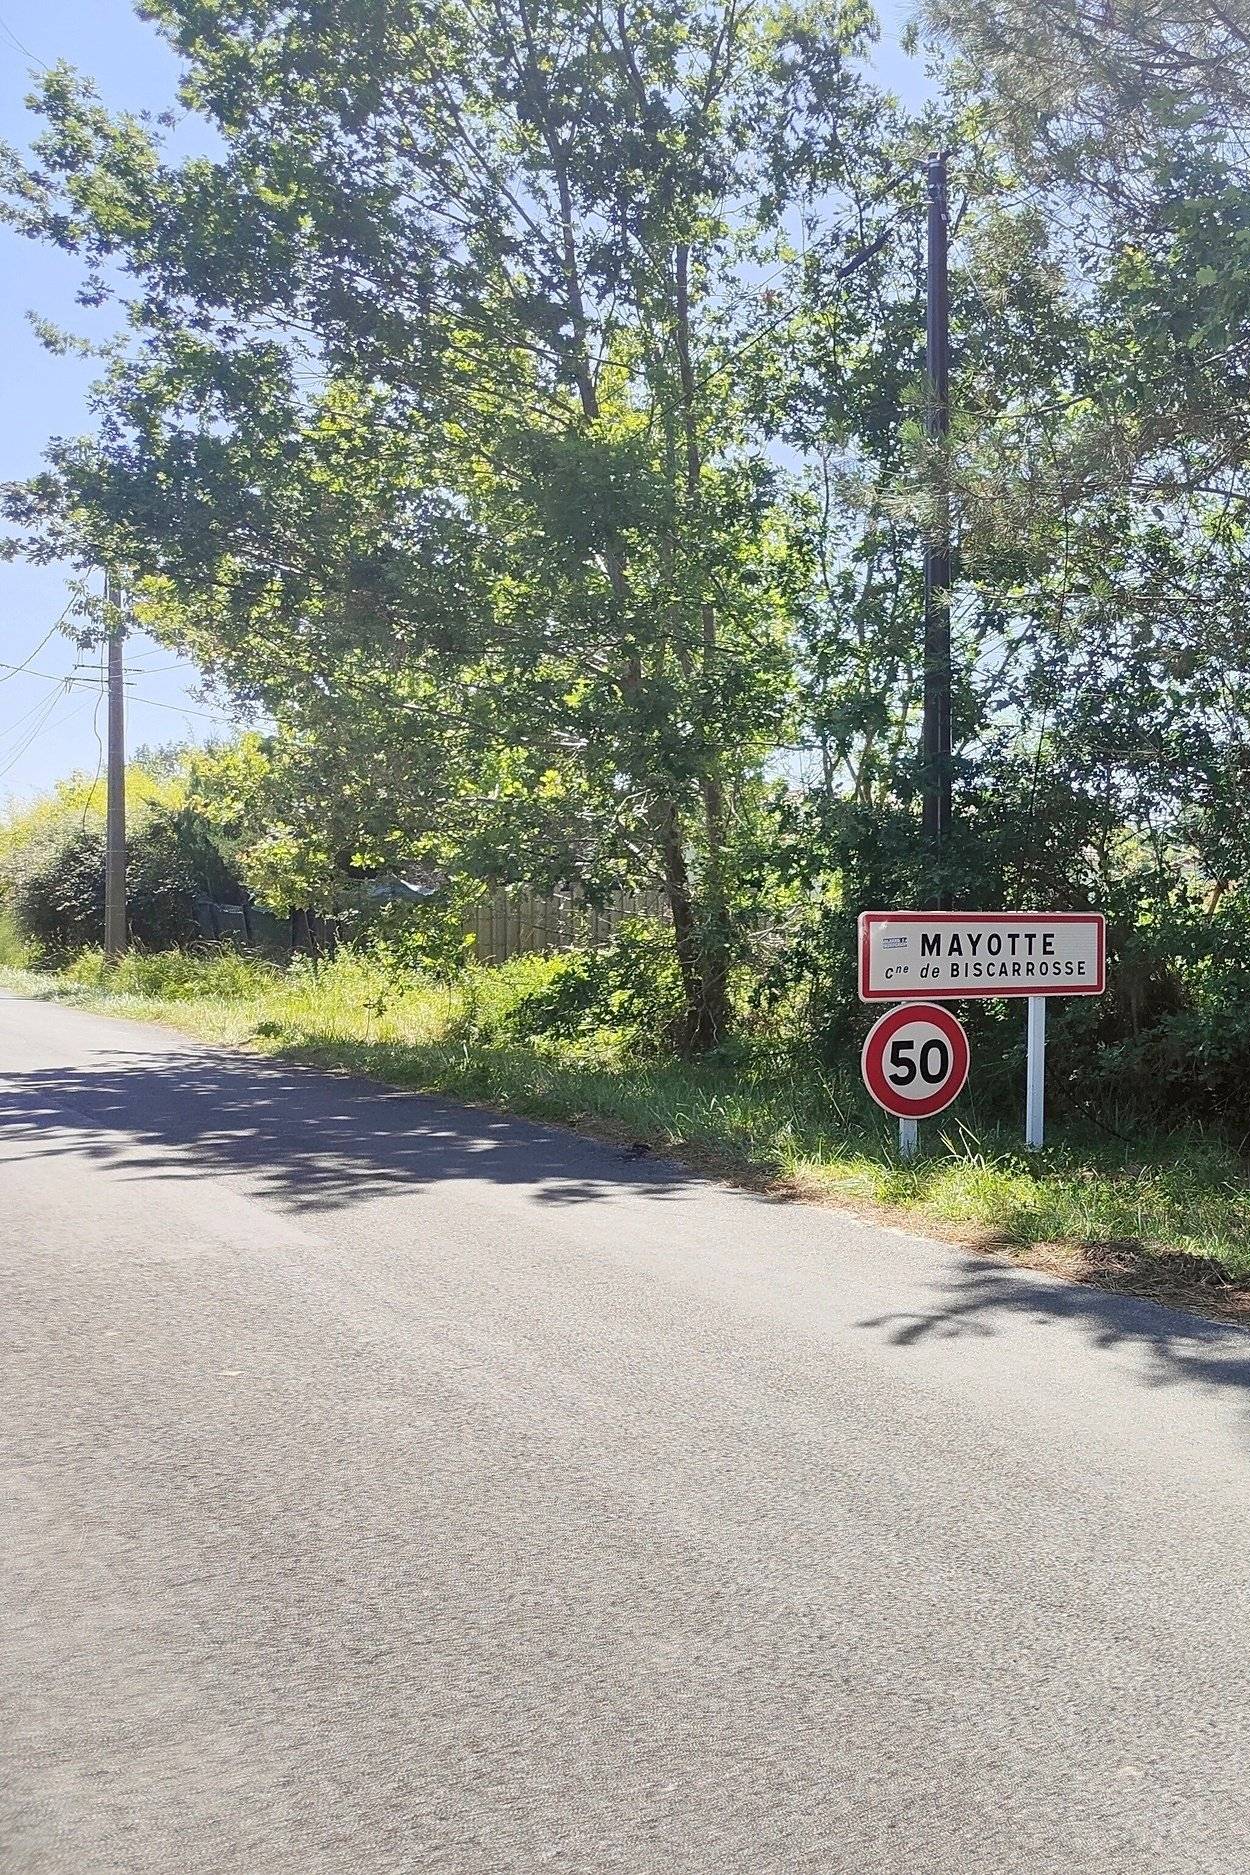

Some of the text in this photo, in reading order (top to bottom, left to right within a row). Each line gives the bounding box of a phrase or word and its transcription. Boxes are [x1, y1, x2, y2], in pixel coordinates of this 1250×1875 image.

[920, 933, 1055, 957] MAYOTTE
[920, 962, 940, 979] de
[950, 960, 1086, 978] BISCARROSSE
[888, 1038, 949, 1086] 50
